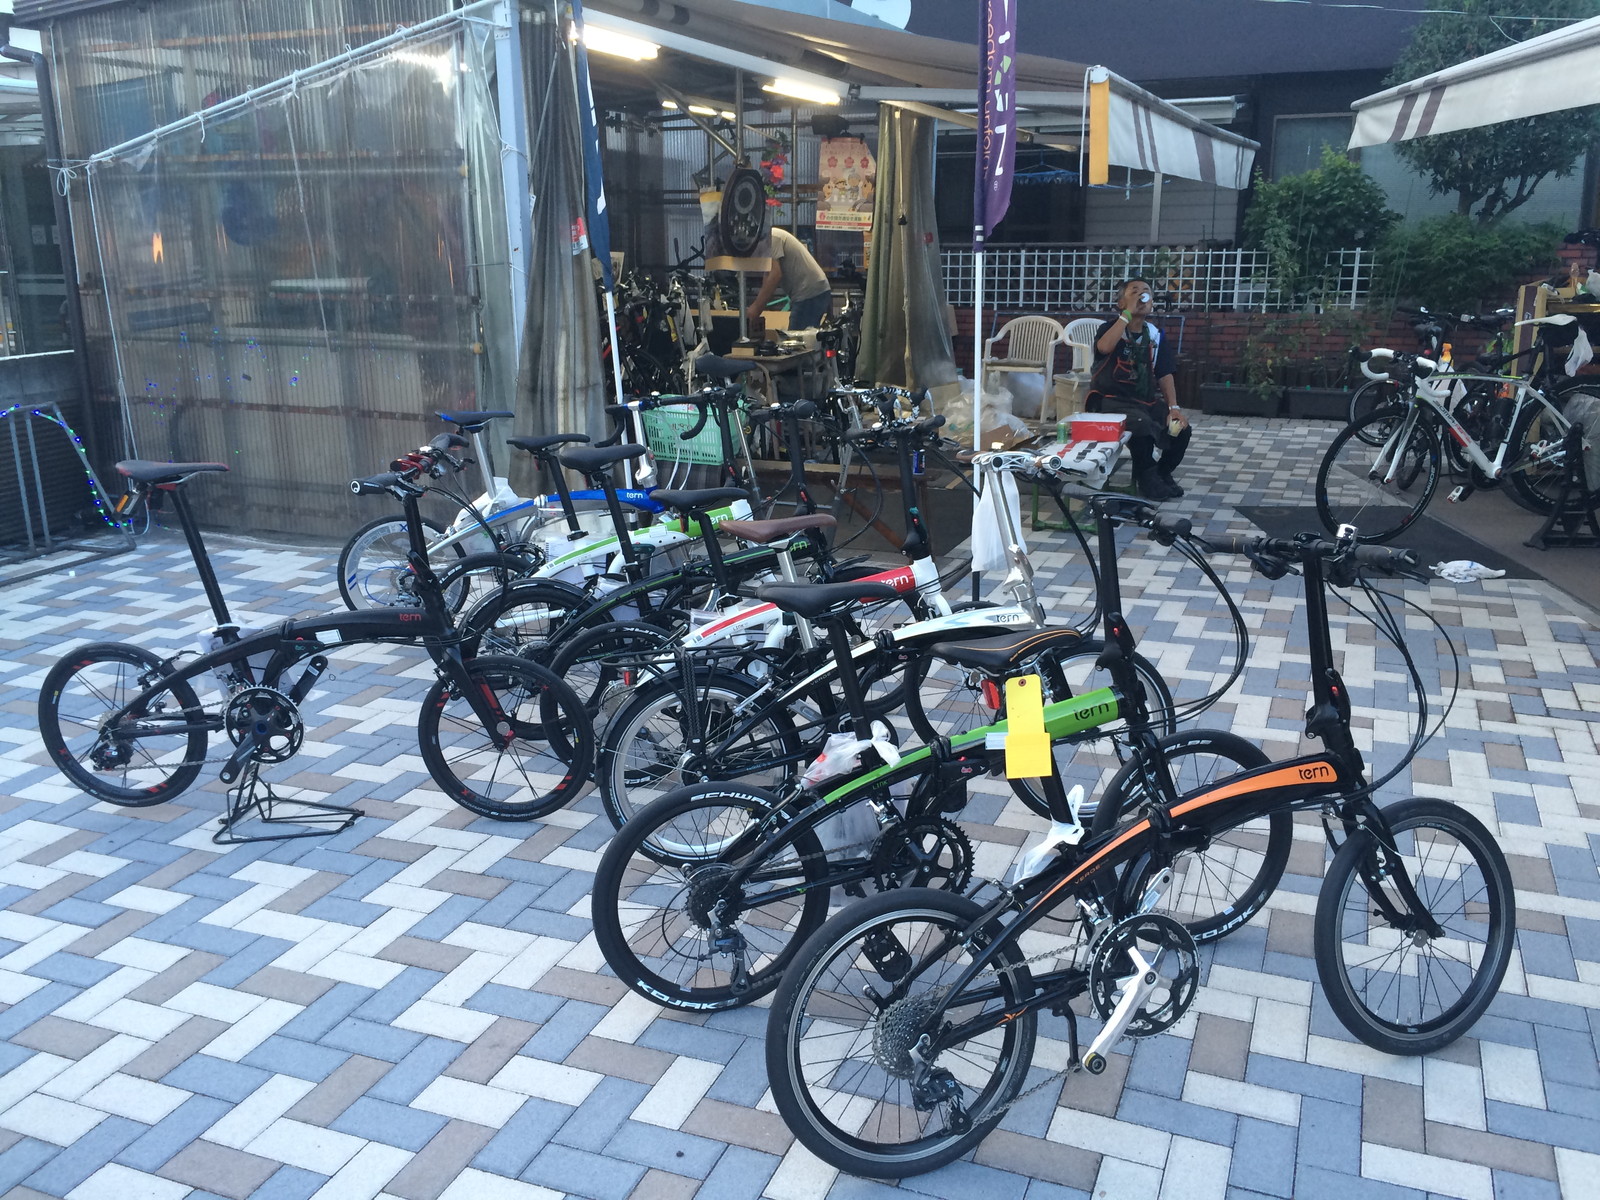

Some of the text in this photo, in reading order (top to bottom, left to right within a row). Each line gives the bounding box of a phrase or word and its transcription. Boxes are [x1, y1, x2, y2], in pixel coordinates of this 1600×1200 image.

[710, 513, 728, 525] ern
[881, 575, 909, 587] ern
[400, 613, 422, 621] tern
[996, 614, 1019, 623] tern
[1074, 703, 1110, 720] tern
[1299, 766, 1329, 780] tern
[636, 978, 719, 1010] KOJAK
